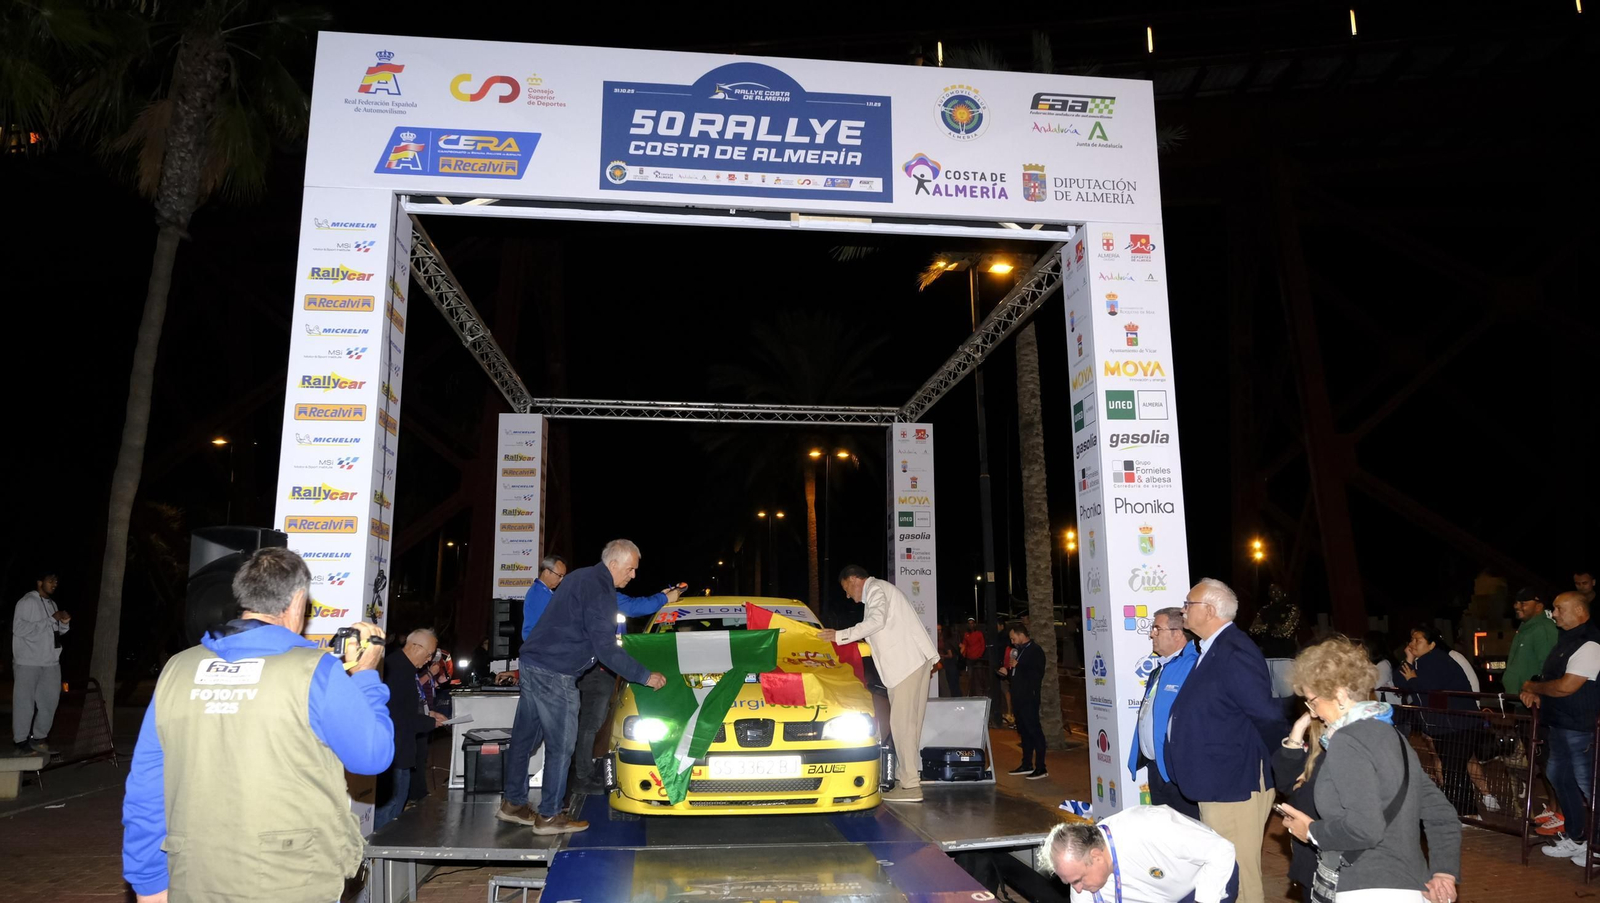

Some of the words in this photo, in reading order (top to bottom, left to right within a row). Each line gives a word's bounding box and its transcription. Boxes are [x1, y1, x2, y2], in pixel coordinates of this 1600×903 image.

[629, 109, 686, 137] 50
[690, 112, 865, 145] RALLYE
[1032, 122, 1081, 135] Andalucía
[438, 135, 520, 152] CERA
[628, 140, 709, 158] COSTA
[714, 145, 747, 161] DE
[752, 148, 862, 165] ALMERÍA
[453, 160, 504, 172] Recalvi
[945, 170, 987, 182] COSTA
[990, 172, 1006, 182] DE
[932, 182, 1008, 200] ALMERÍA
[1054, 177, 1137, 192] DIPUTACIÓN
[1054, 190, 1072, 201] DE
[1075, 192, 1135, 205] ALMERÍA
[311, 267, 374, 281] Rallycar
[318, 298, 360, 308] Recalvi
[1104, 360, 1165, 377] MOYA
[301, 375, 366, 389] Rallycar
[309, 407, 352, 418] Recalvi
[1110, 430, 1169, 448] gasolia
[292, 486, 358, 500] Rallycar
[1114, 498, 1175, 514] Phonika
[298, 519, 344, 530] Recalvi
[899, 532, 931, 541] gasolia
[900, 567, 931, 575] Phonika
[656, 612, 679, 622] 33
[738, 760, 774, 774] 3362
